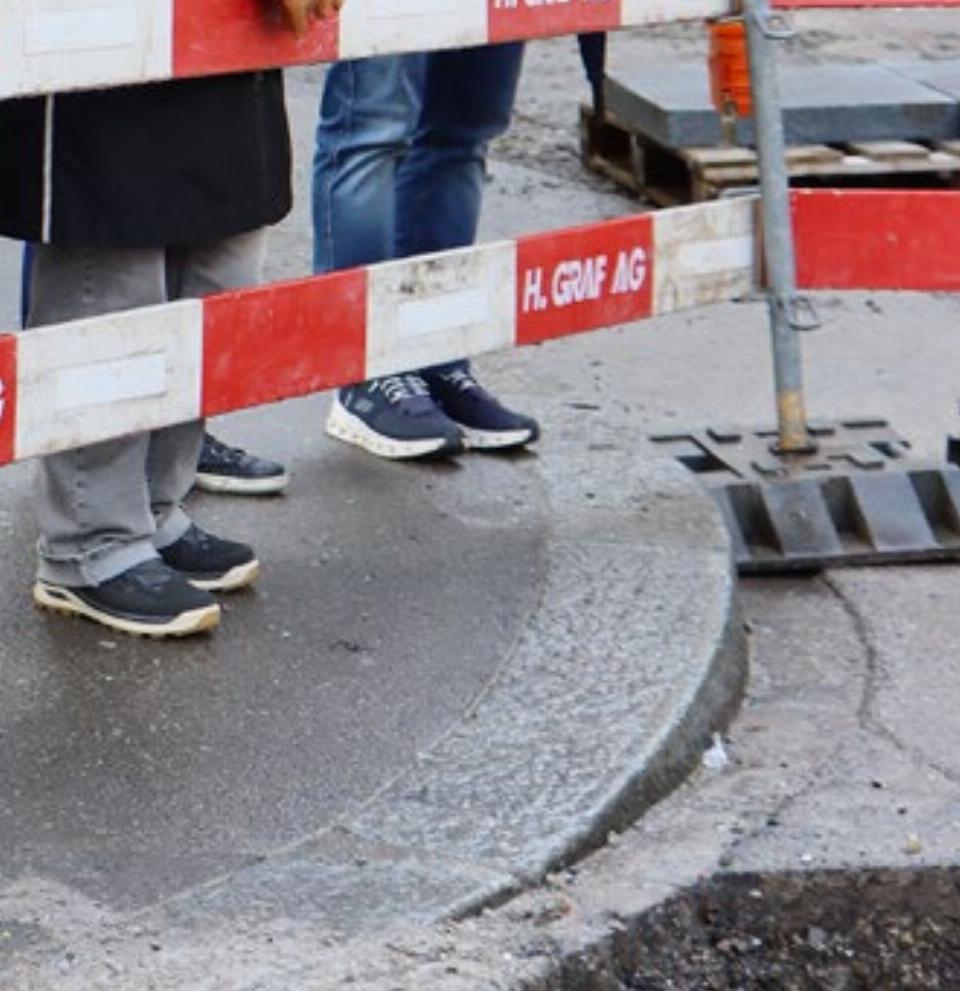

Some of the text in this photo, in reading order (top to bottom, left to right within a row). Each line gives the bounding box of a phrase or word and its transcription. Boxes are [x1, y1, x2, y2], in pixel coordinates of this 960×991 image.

[522, 247, 646, 313] H. GRAF AG
